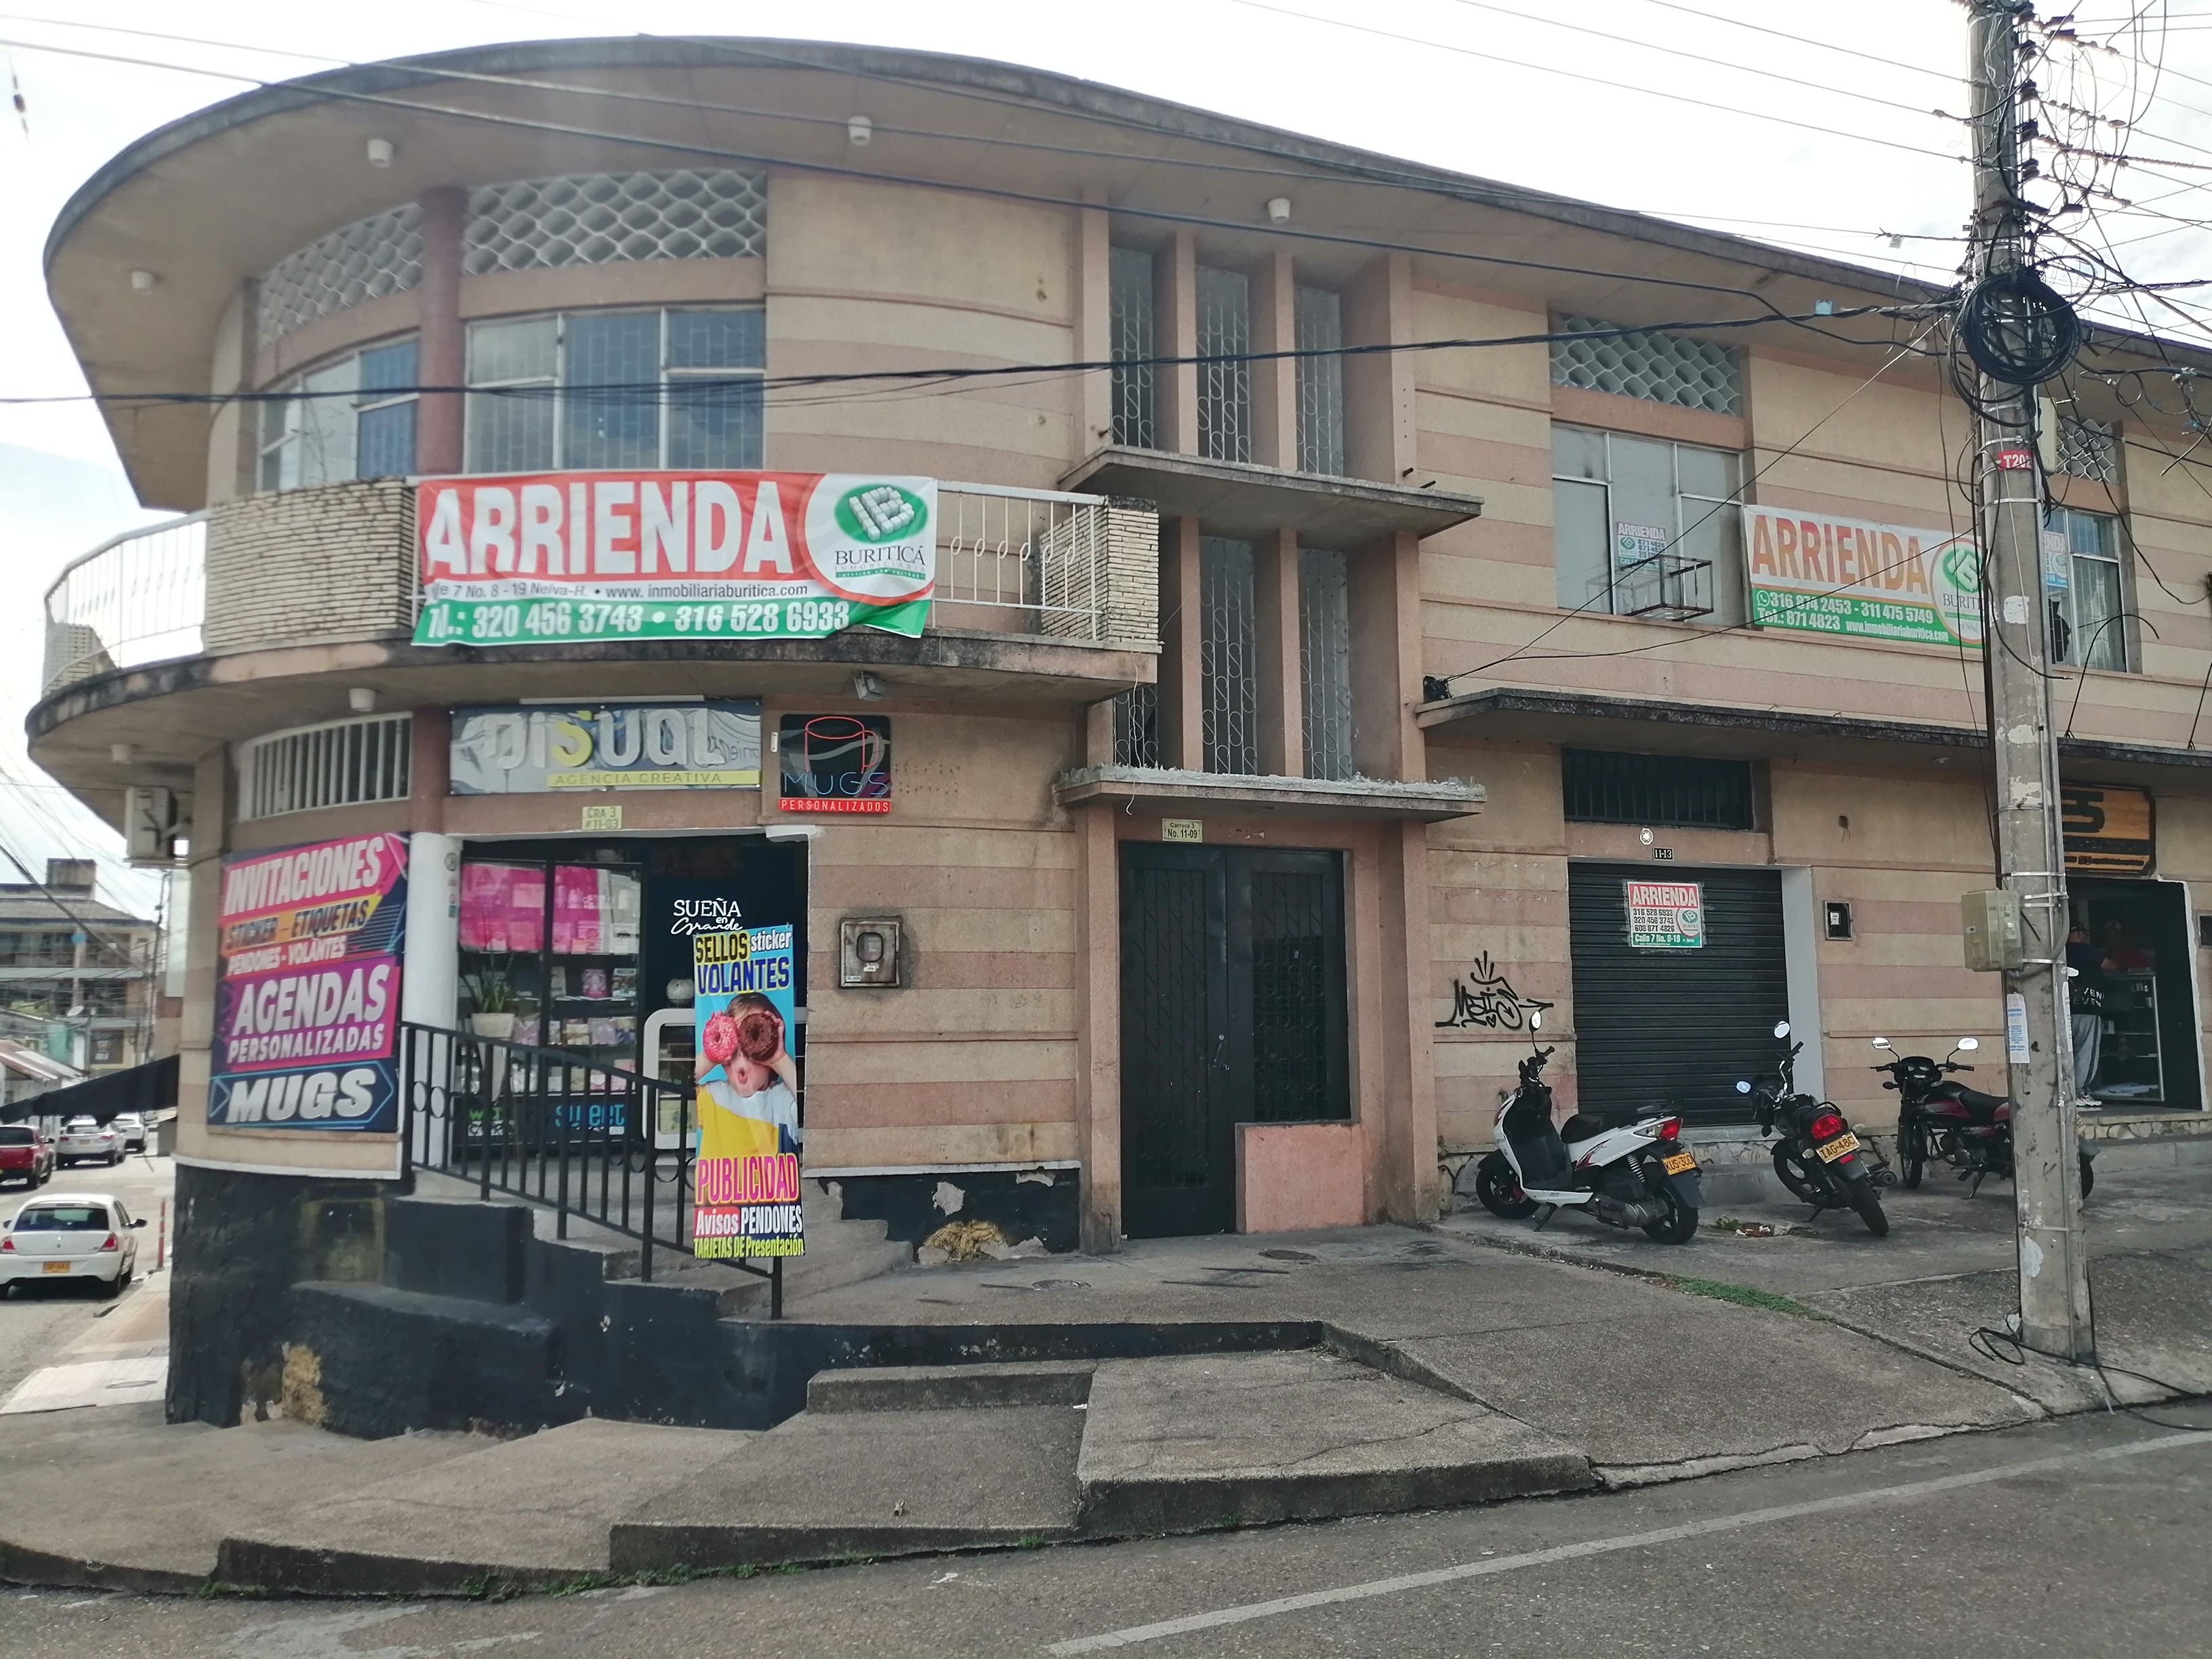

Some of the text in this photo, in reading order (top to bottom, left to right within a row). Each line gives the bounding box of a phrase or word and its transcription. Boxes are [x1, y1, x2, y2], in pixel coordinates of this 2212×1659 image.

[427, 481, 794, 575] ARRIENDA
[1618, 523, 1666, 541] ARRIENDA
[835, 546, 926, 565] BURITICÁ
[1752, 514, 1929, 594] ARRIENDA
[454, 585, 462, 597] 7
[466, 585, 487, 598] No.
[648, 583, 808, 598] inmobiliariaburitica.com
[472, 605, 520, 638] 320
[525, 602, 571, 635] 456
[578, 603, 644, 634] 3743
[674, 605, 724, 632] 316
[730, 602, 780, 632] 528
[785, 600, 850, 632] 6933
[1757, 607, 1841, 630] Tel.: 871 4823
[1770, 592, 1793, 608] 316
[1821, 596, 1852, 615] 2453
[1861, 602, 1881, 618] 311
[1883, 605, 1903, 621] 475
[1906, 607, 1934, 624] 5749
[555, 772, 722, 785] AGENCIA CREATIVA
[784, 771, 888, 795] MUGS
[610, 806, 616, 818] 3
[781, 800, 888, 812] PERSONALIZADOS
[1168, 828, 1197, 838] No. 11-09
[224, 836, 384, 916] INVITACIONES
[673, 897, 742, 918] SUEÑA
[1632, 886, 1698, 907] ARRIENDA
[291, 899, 369, 939] ETIQUETAS
[670, 918, 743, 936] Grande
[288, 935, 347, 966] VOLANTES
[695, 929, 792, 964] SELLOS sticker
[697, 956, 790, 994] VOLANTES
[231, 964, 390, 1037] AGENDAS
[227, 1023, 385, 1064] PERSONALIZADAS
[226, 1068, 377, 1123] MUGS
[697, 1154, 799, 1203] PUBLICIDAD
[695, 1205, 803, 1235] Avisos PENDONES
[694, 1233, 804, 1258] TARJETAS DE Presentación
